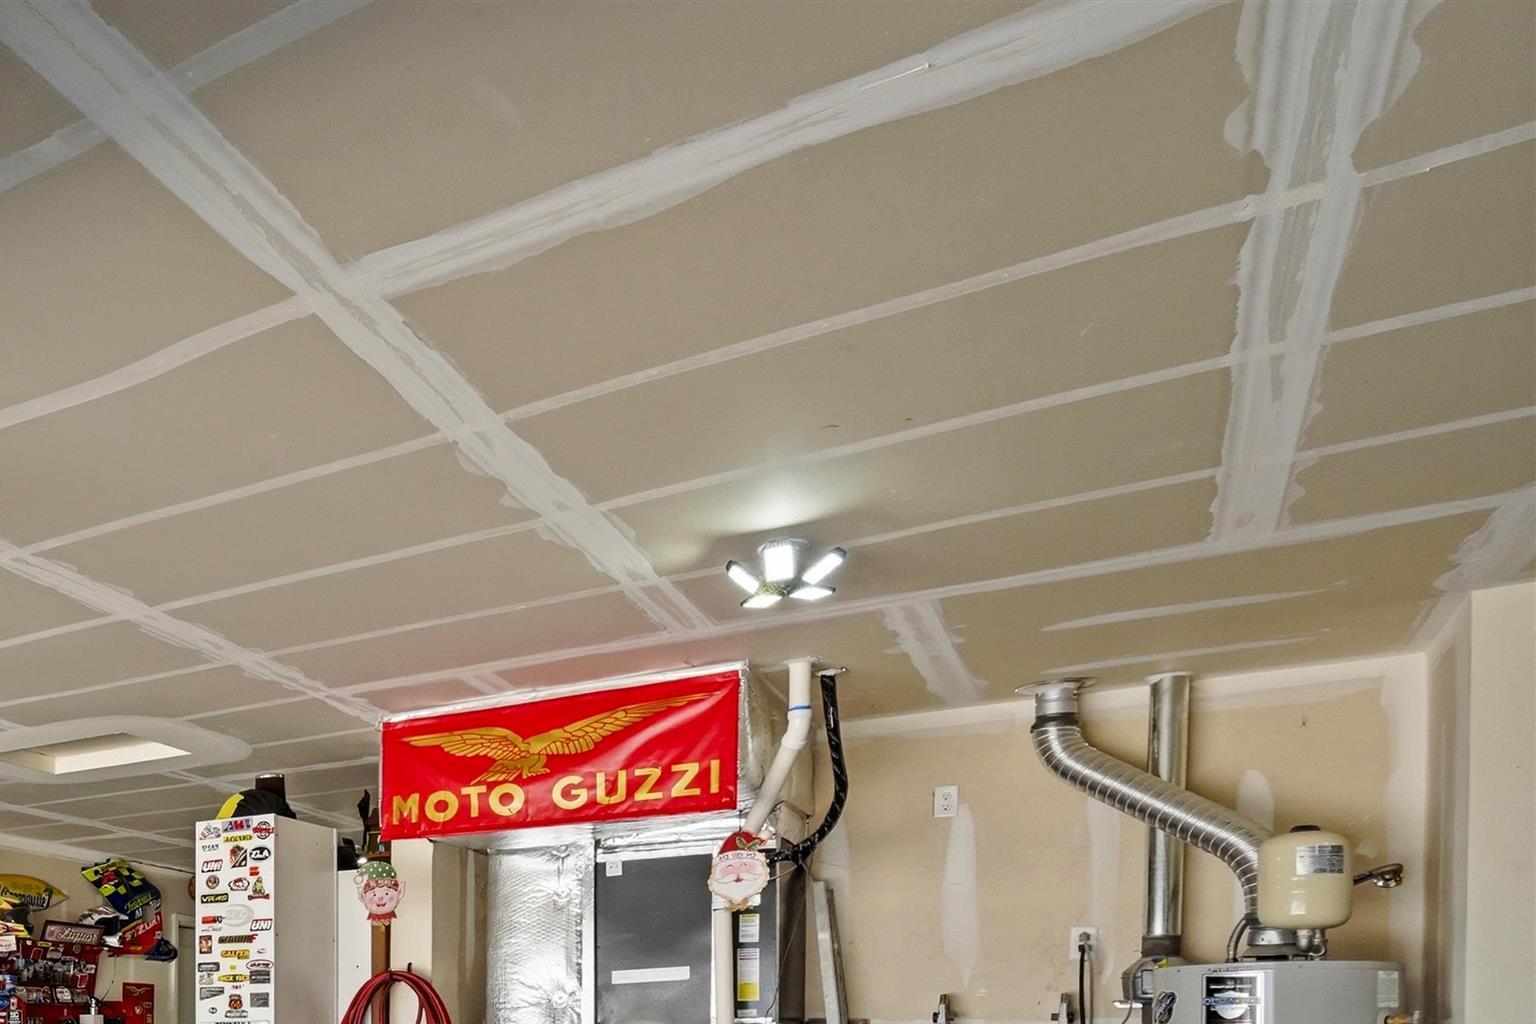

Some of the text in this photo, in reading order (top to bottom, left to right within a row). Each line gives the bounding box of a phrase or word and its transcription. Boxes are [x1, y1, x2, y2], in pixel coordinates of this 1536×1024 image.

[391, 759, 721, 826] MOTO GUZZI
[251, 920, 271, 930] UNI
